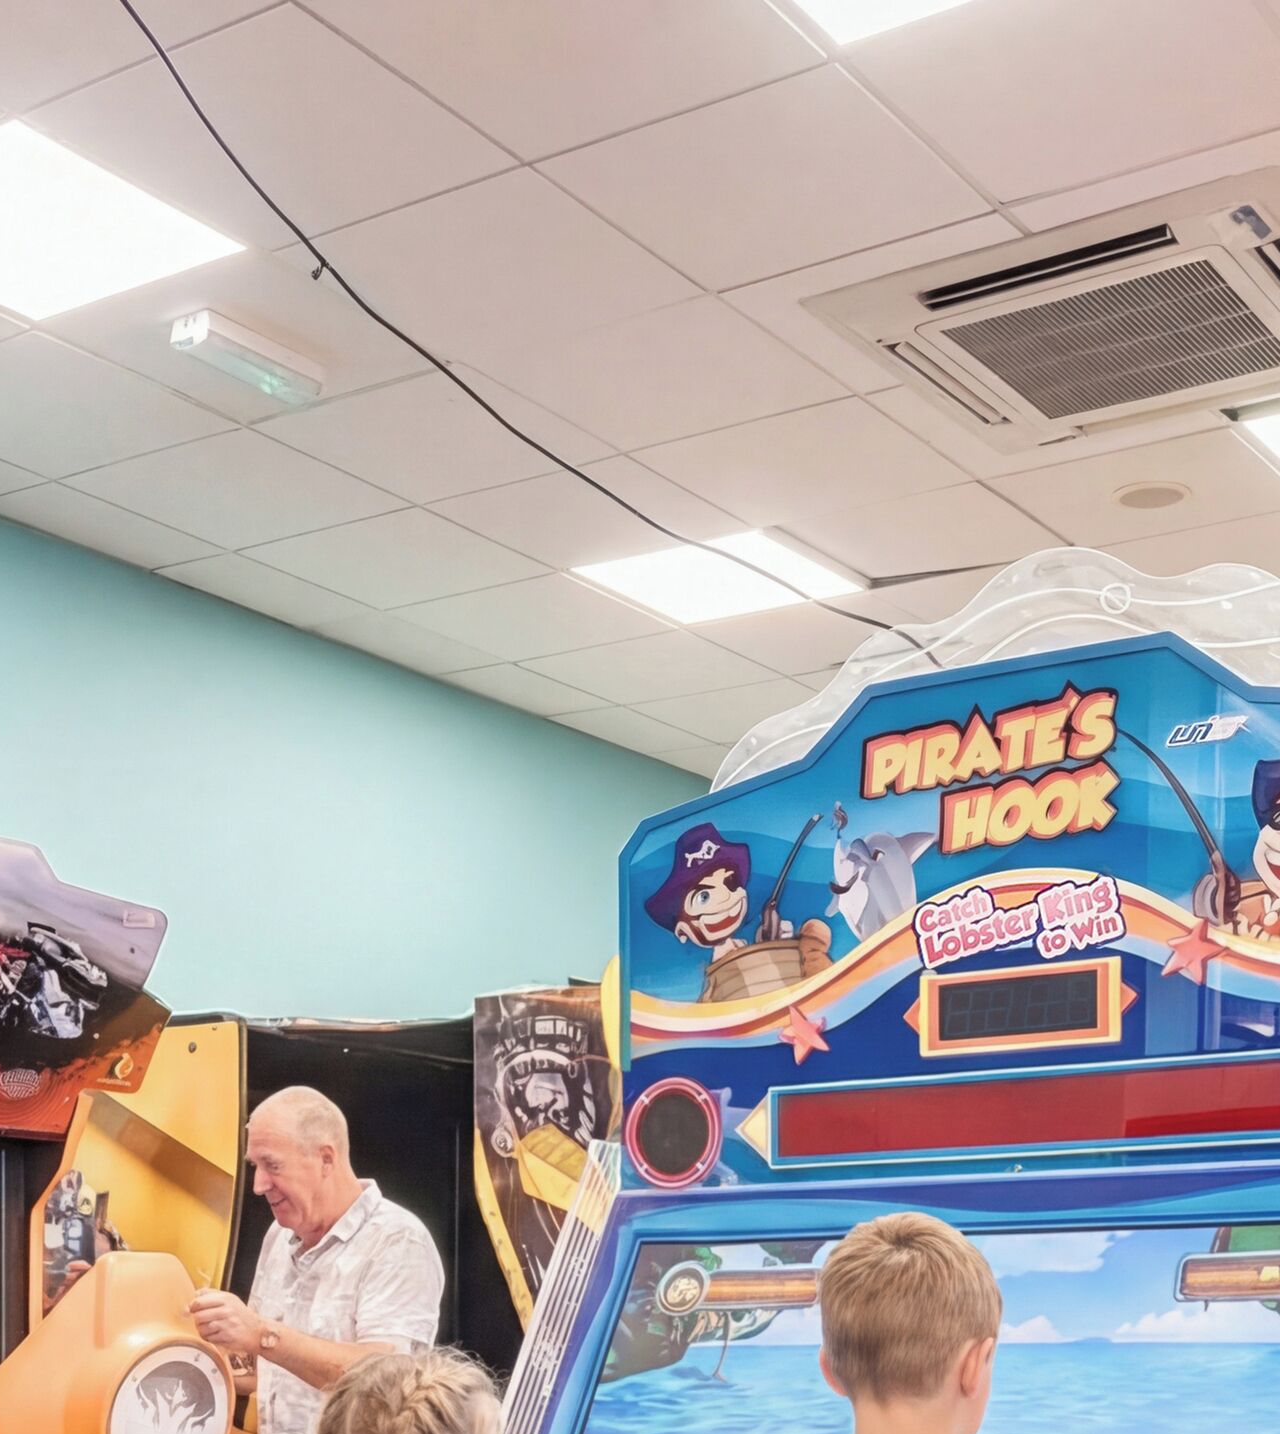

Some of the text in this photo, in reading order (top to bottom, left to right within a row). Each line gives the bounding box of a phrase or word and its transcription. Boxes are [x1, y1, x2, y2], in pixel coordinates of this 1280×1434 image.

[861, 683, 1118, 798] PIRATE'S
[940, 760, 1120, 853] HOOK
[919, 880, 1114, 932] Catch King
[925, 910, 1036, 964] Lobster
[1042, 915, 1119, 955] to Win
